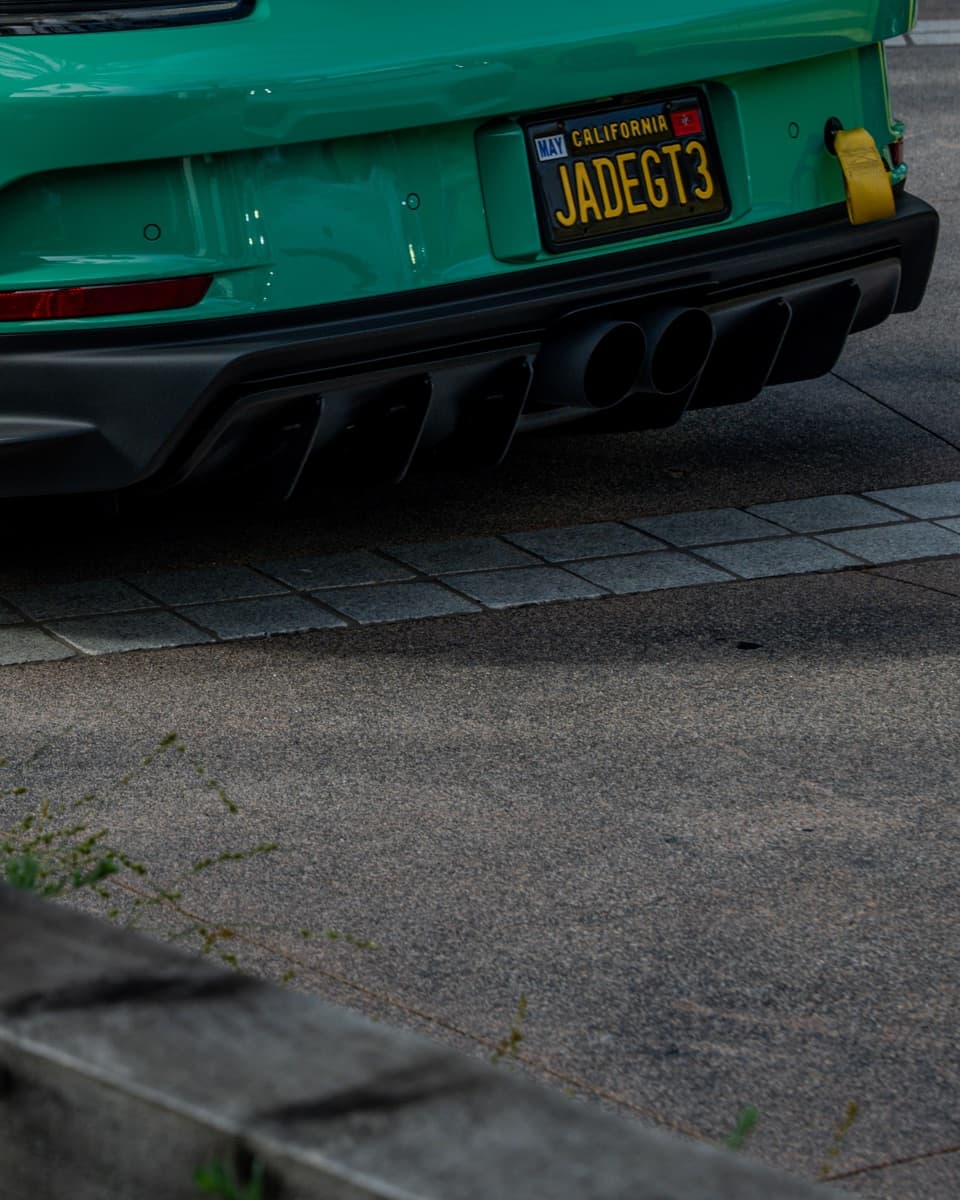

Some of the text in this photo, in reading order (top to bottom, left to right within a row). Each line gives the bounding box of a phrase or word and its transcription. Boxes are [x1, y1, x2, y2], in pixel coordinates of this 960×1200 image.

[539, 136, 563, 158] MAY
[571, 114, 669, 148] CALIFORNIA
[555, 140, 715, 227] JADEGT3
